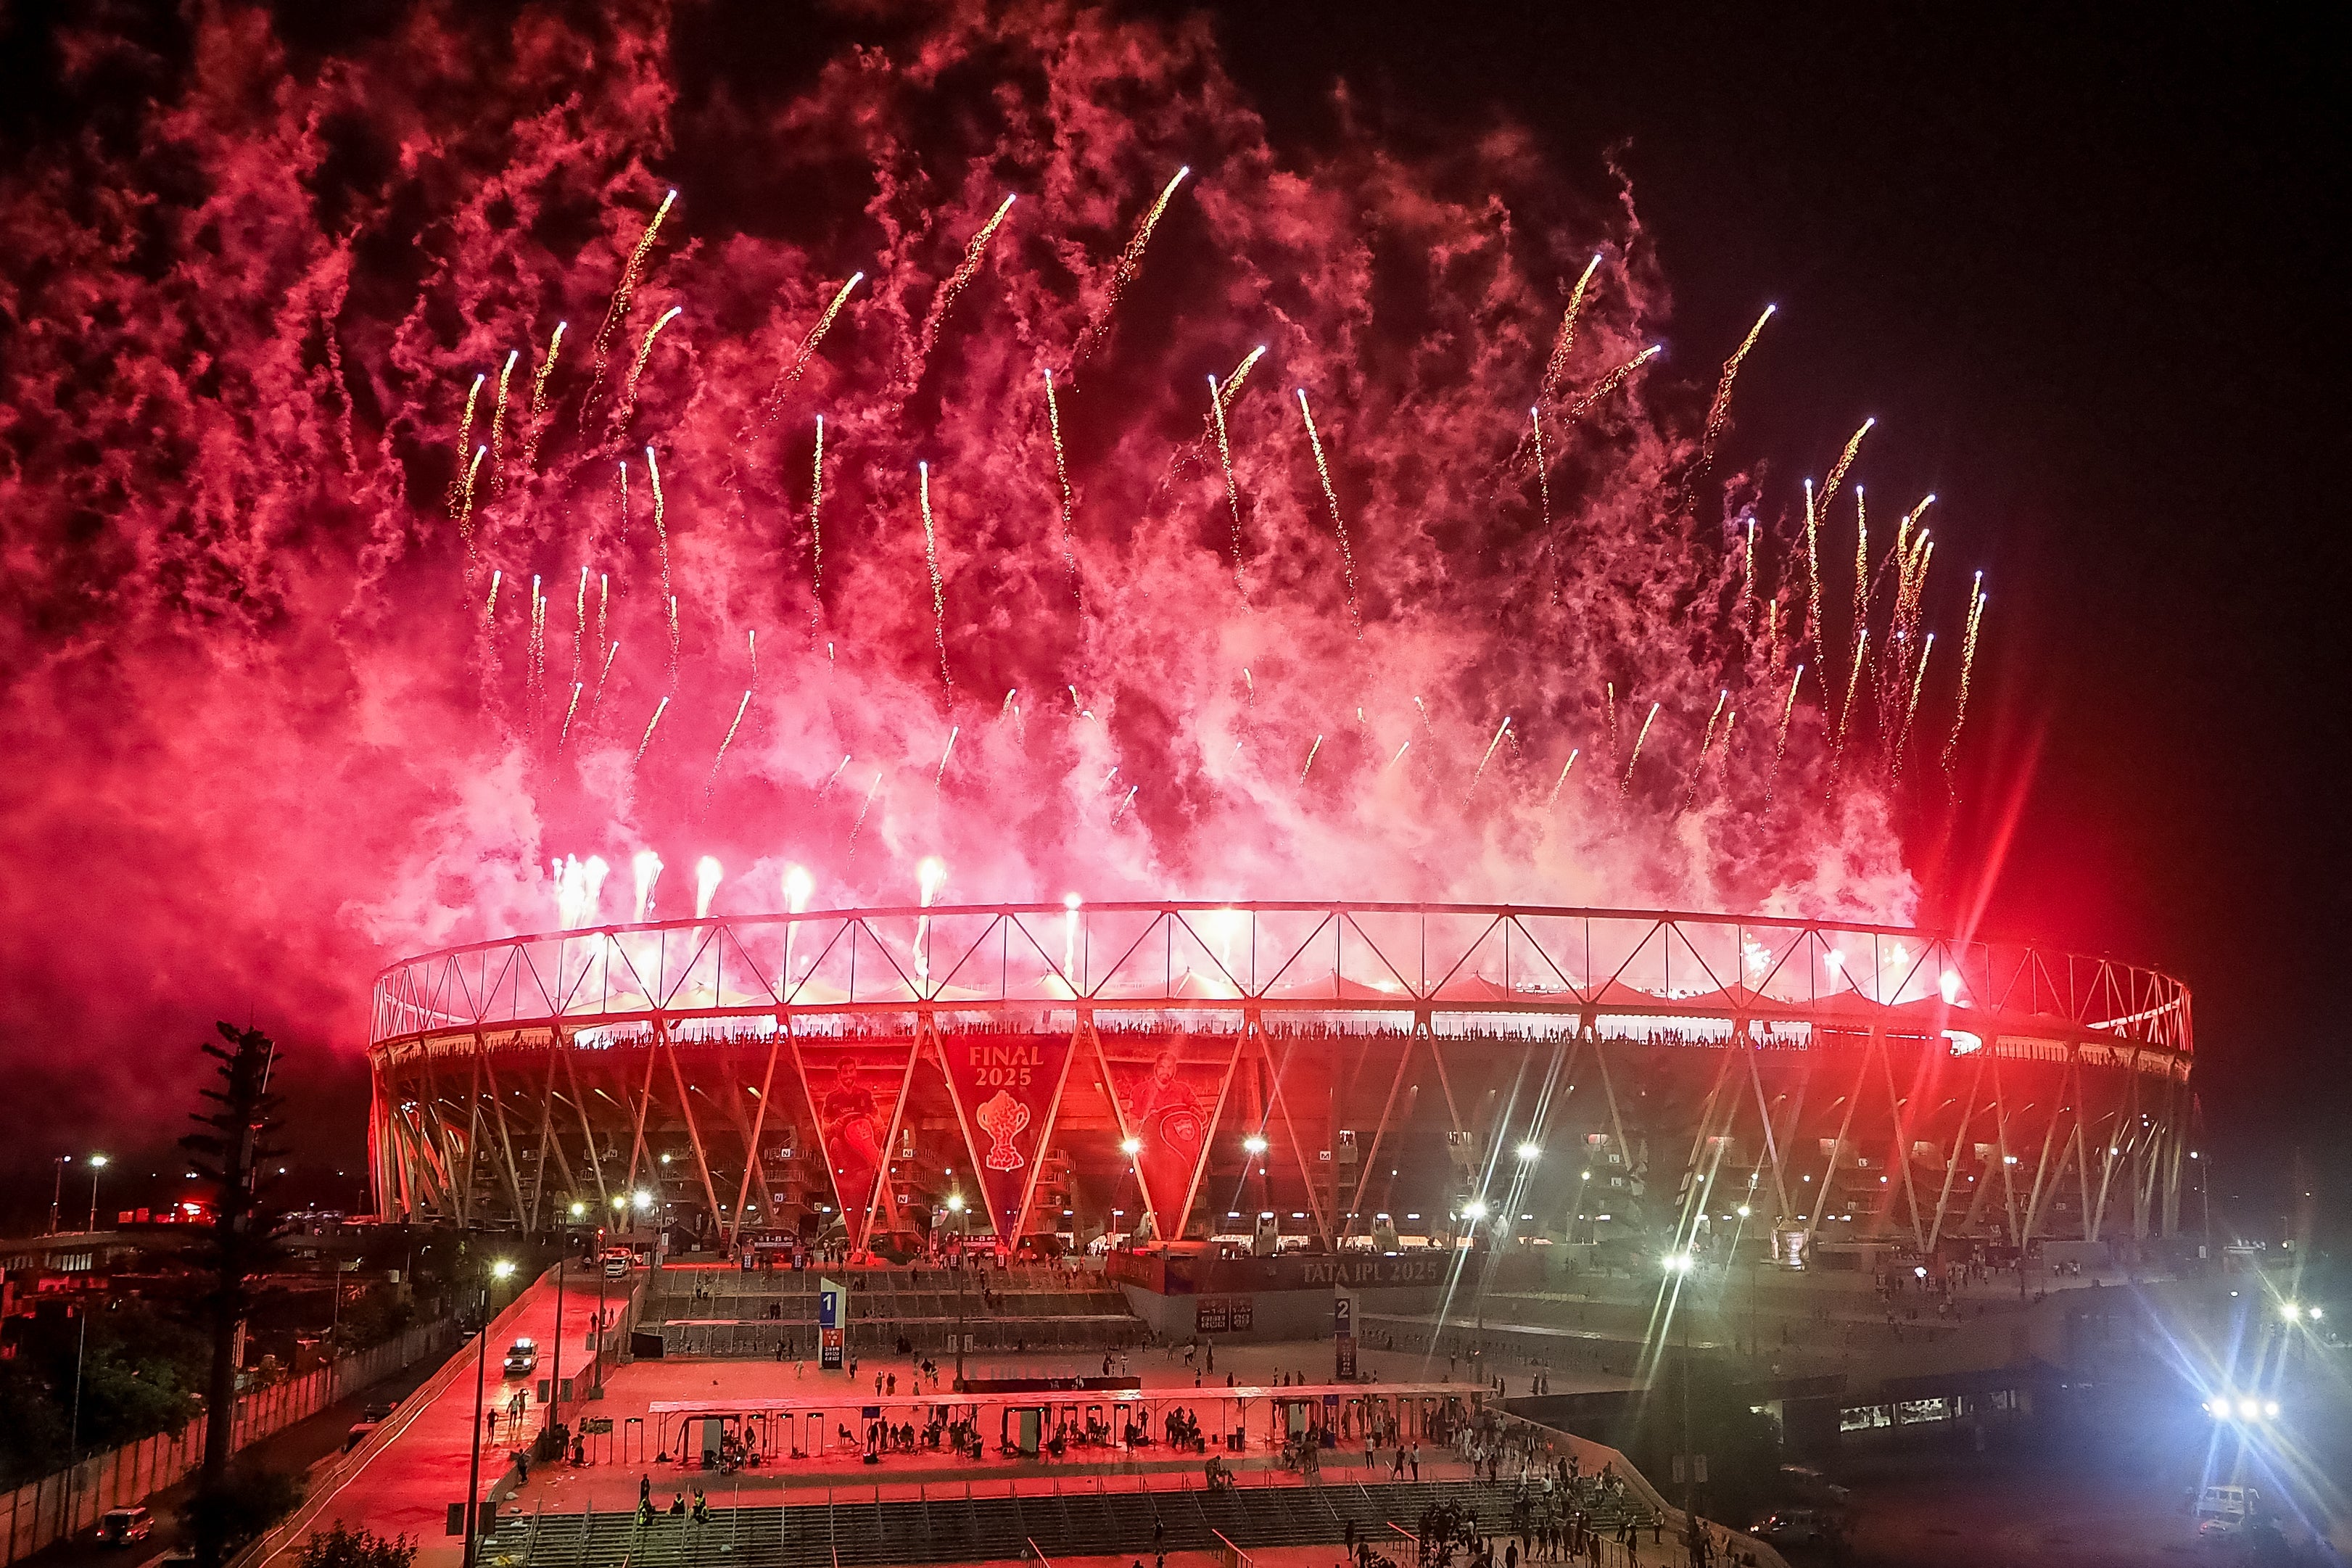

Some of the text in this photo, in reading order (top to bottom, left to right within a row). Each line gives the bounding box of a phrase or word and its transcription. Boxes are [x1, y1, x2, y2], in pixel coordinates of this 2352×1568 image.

[969, 1045, 1044, 1066] FINAL
[975, 1068, 1031, 1086] 2025
[1303, 1261, 1438, 1282] TATA IPL 2025
[822, 1294, 832, 1311] 1
[1337, 1300, 1349, 1319] 2
